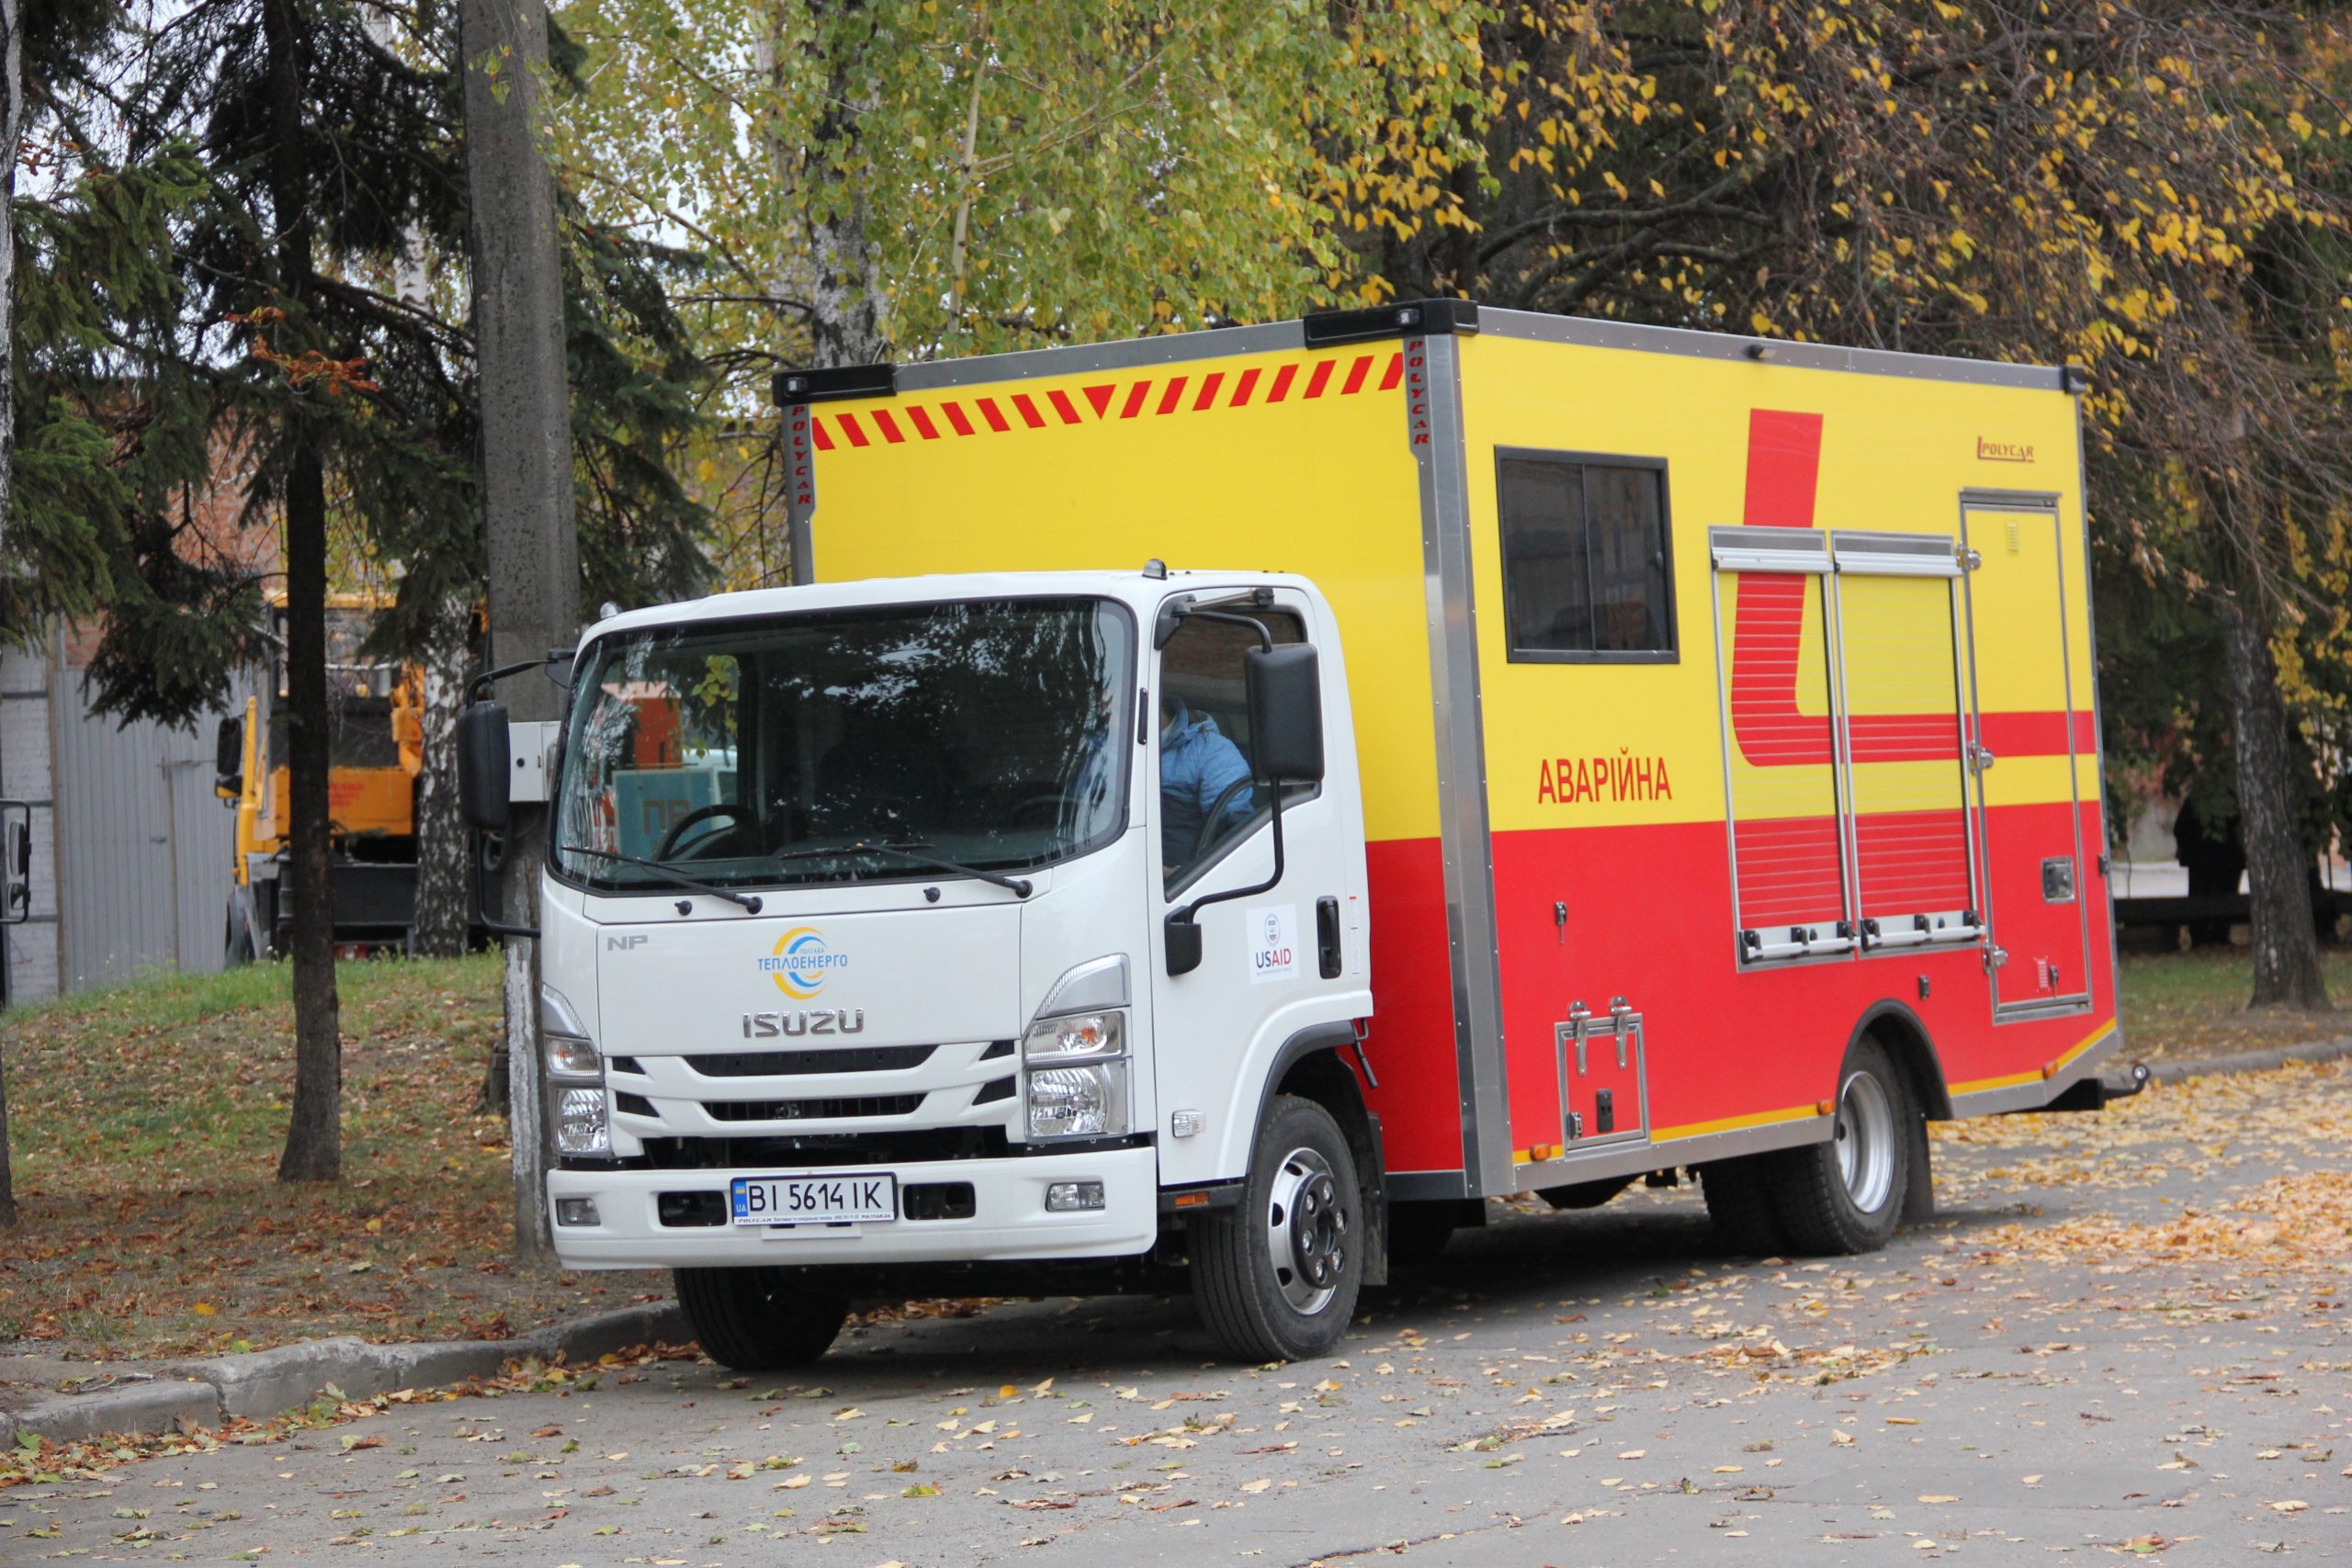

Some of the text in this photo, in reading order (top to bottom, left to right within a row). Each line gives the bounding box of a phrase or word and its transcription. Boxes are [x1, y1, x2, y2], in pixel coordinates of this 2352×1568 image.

[1408, 340, 1430, 445] POLYCAR
[792, 405, 811, 504] POLYCAR
[1981, 441, 2035, 462] POLYCAR
[1538, 746, 1673, 805] АВАРІЙНА
[607, 935, 649, 951] NP
[757, 954, 848, 971] ТЕПЛОЕНЕРГО
[1255, 948, 1292, 969] USAID
[742, 1007, 865, 1039] ISUZU
[736, 1204, 747, 1213] UA
[789, 1182, 844, 1211] 5614
